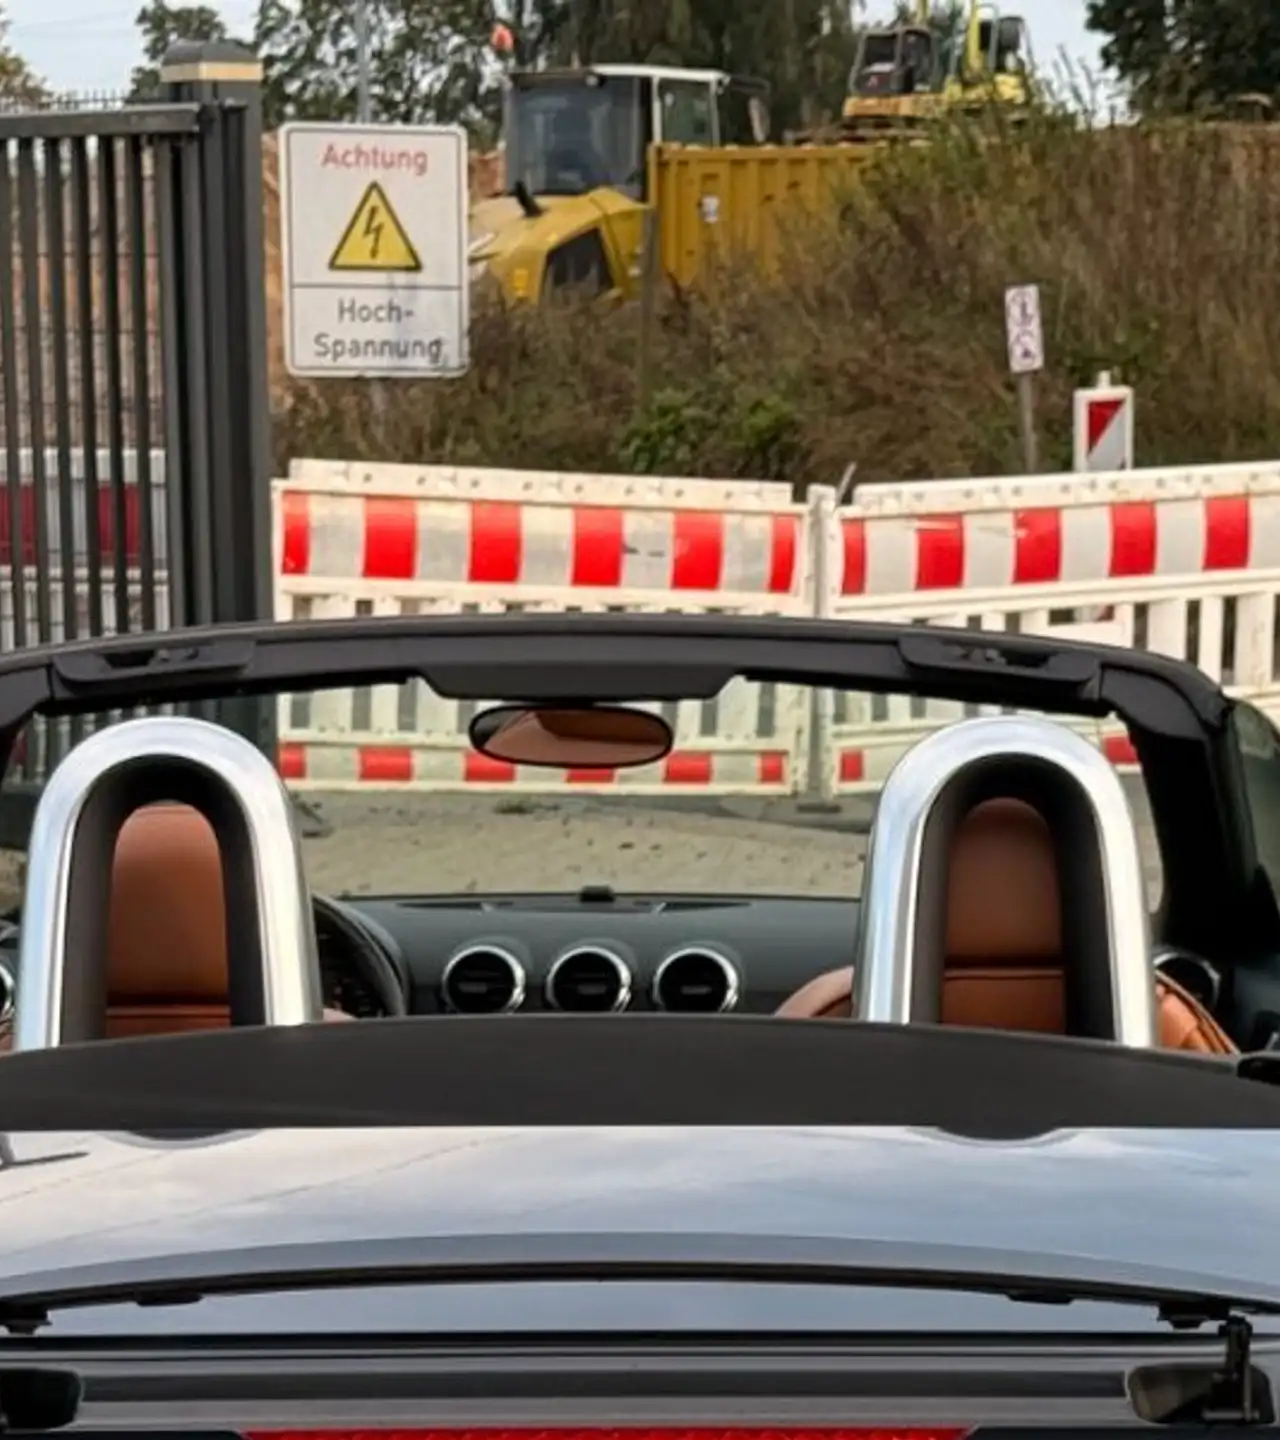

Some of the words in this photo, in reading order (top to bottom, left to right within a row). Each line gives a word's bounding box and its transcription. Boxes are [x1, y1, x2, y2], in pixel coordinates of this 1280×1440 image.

[321, 144, 429, 176] Achtung
[337, 298, 415, 323] Hoch-
[314, 333, 443, 364] Spannung
